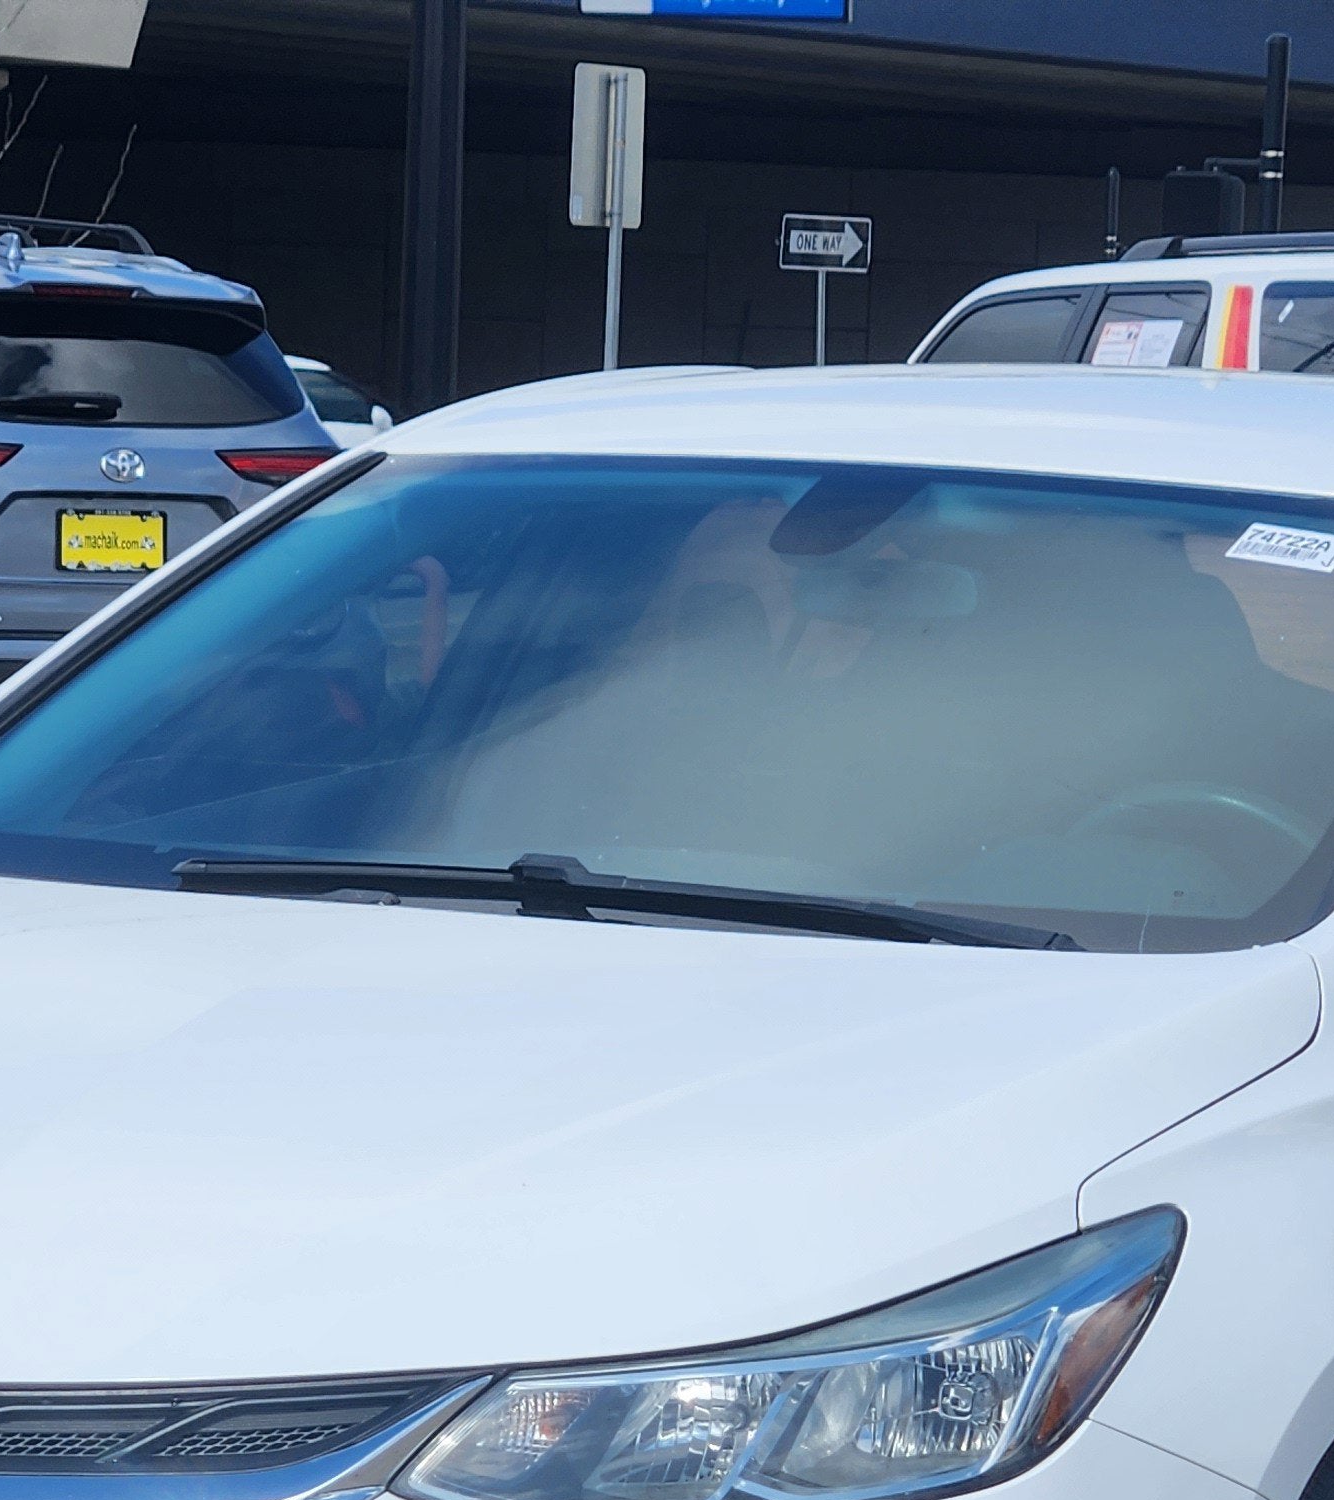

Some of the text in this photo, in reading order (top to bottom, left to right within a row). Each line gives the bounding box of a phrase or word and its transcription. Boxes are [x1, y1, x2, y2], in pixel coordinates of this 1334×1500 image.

[796, 233, 843, 251] ONE WAY
[84, 530, 140, 550] machaik.com
[1247, 528, 1332, 552] 74722A
